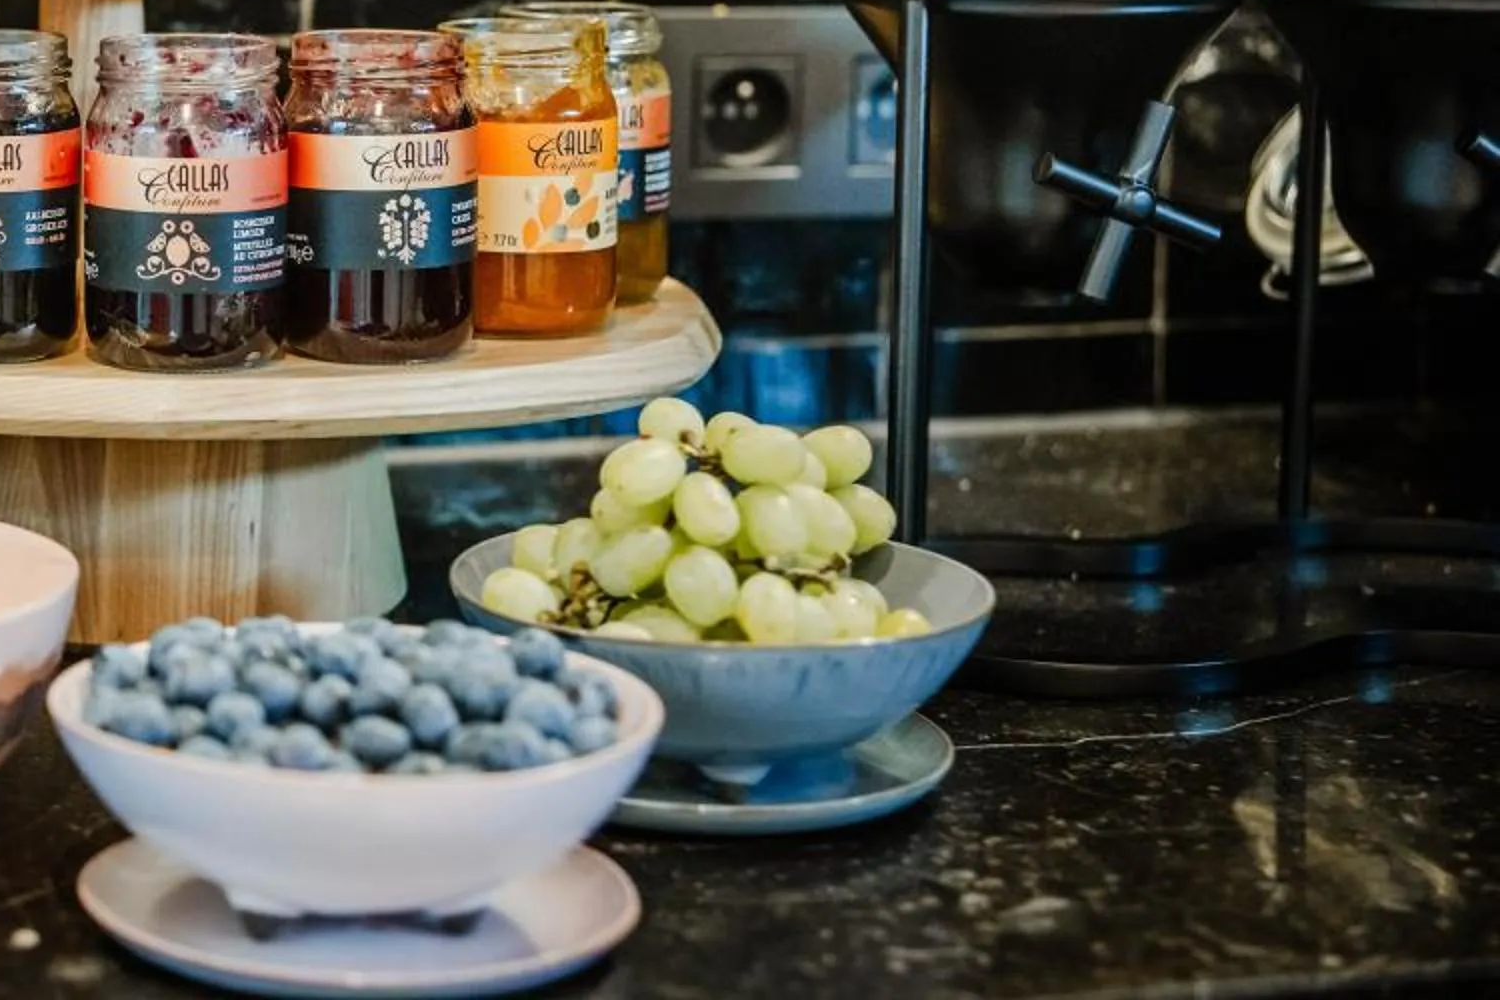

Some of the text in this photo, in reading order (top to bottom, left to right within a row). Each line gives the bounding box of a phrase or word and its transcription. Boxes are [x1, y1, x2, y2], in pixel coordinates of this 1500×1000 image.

[394, 138, 450, 169] CALLAS
[556, 128, 603, 156] CALLAS
[167, 164, 229, 193] CALLAS
